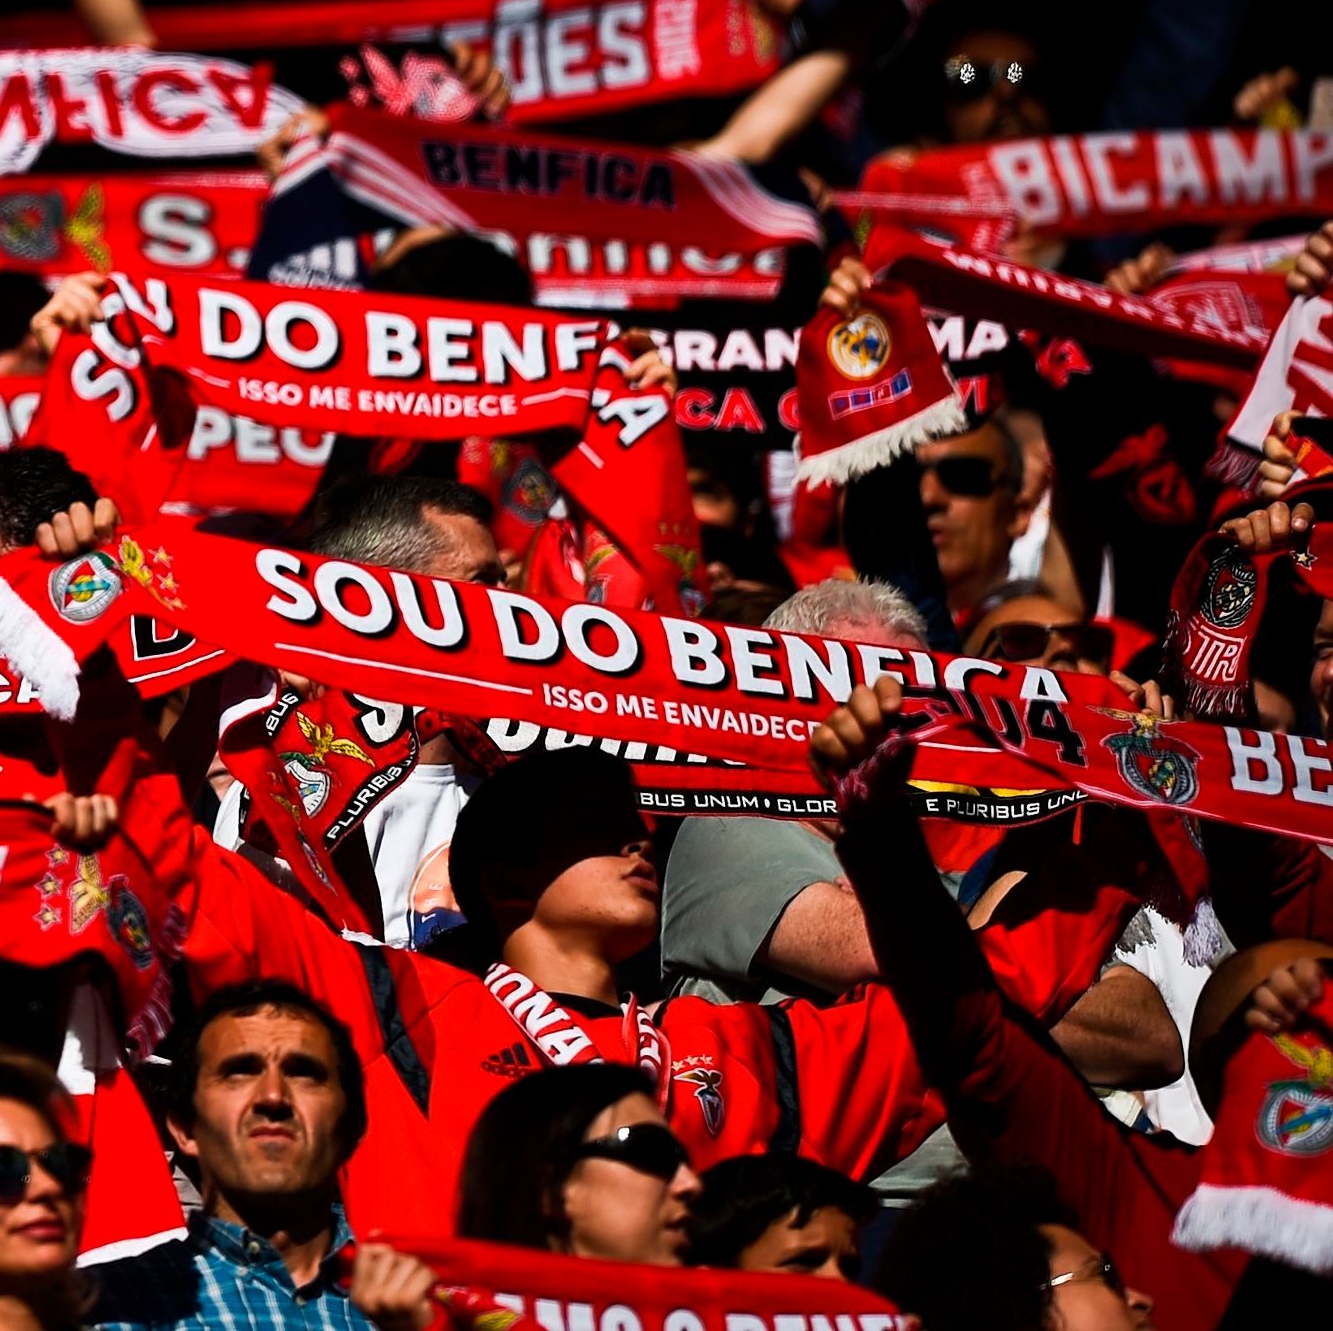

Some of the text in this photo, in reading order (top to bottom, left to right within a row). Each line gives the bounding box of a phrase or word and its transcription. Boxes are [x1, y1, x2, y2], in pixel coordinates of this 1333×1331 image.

[420, 139, 681, 211] BENFICA
[198, 287, 340, 371] DO
[237, 377, 518, 419] ISSO ME ENVAIDECE
[254, 548, 466, 649] SOU
[487, 587, 639, 674] DO
[542, 683, 608, 714] ISSO
[615, 692, 660, 720] ME
[694, 794, 760, 809] UNUM
[925, 798, 940, 812] E
[946, 799, 1041, 820] PLURIBUS
